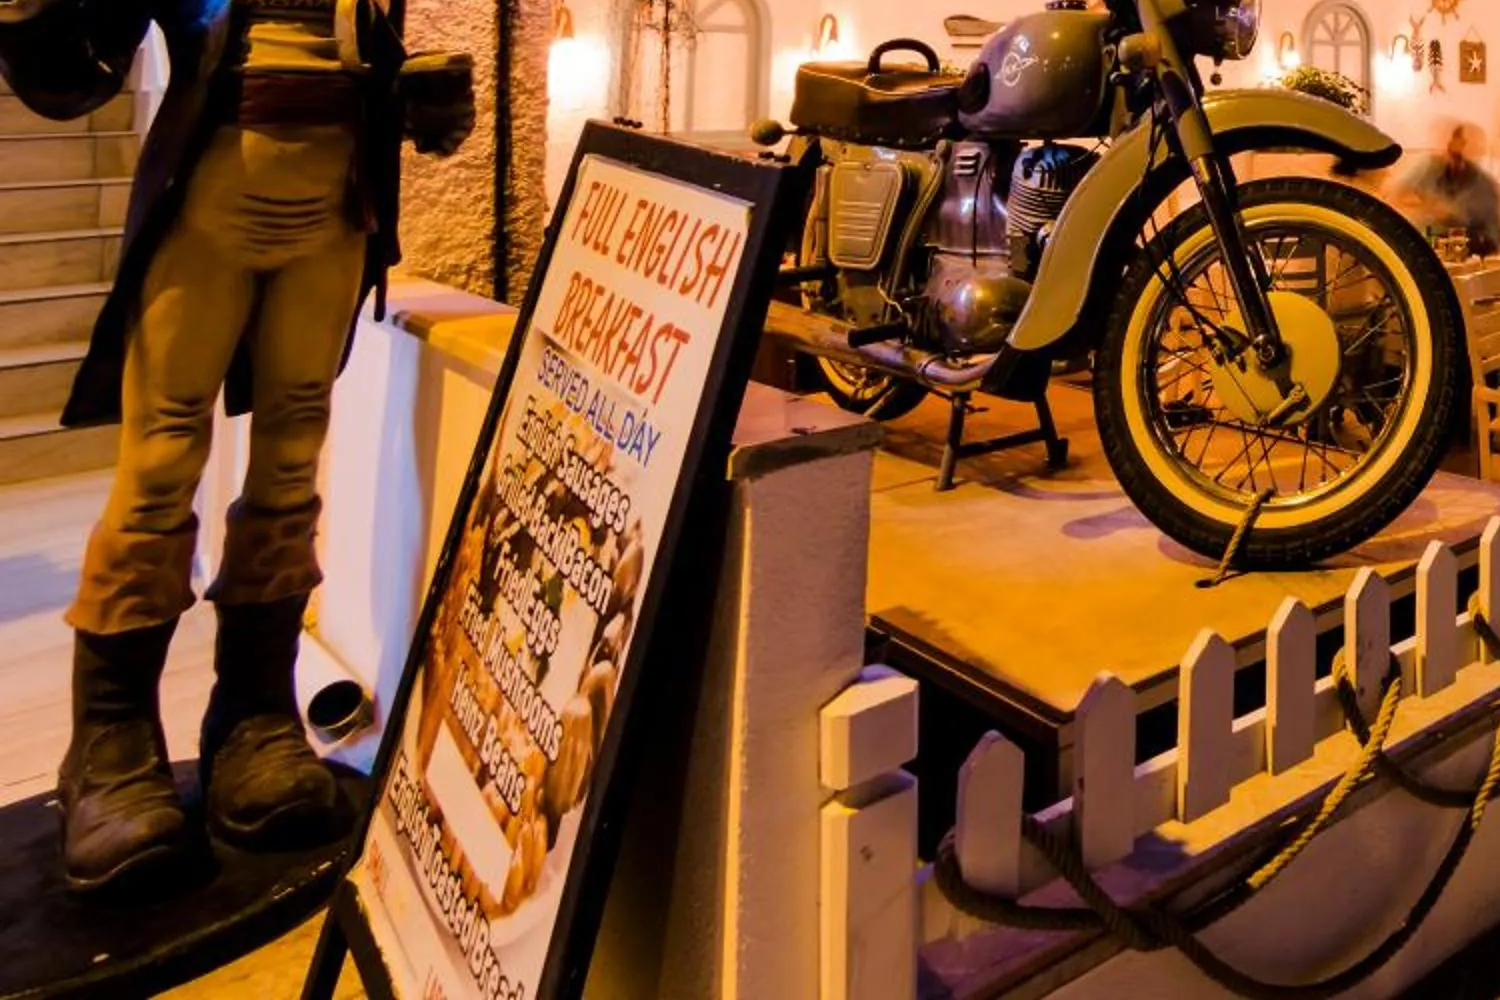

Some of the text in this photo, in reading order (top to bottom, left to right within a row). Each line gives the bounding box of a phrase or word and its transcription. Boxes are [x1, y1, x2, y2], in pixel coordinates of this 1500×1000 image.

[571, 180, 741, 308] FULL ENGLISH
[537, 345, 589, 413] SERVED
[584, 388, 617, 440] ALL
[554, 271, 690, 405] BREAKFAST
[517, 396, 631, 535] English Sausages
[493, 539, 562, 657] Fried Eggs
[529, 492, 566, 570] Back
[562, 521, 615, 617] Bacon
[450, 661, 527, 815] Heinz Beans
[458, 579, 564, 764] Fried Mushrooms
[387, 752, 433, 862] English
[423, 822, 480, 956] Toasted
